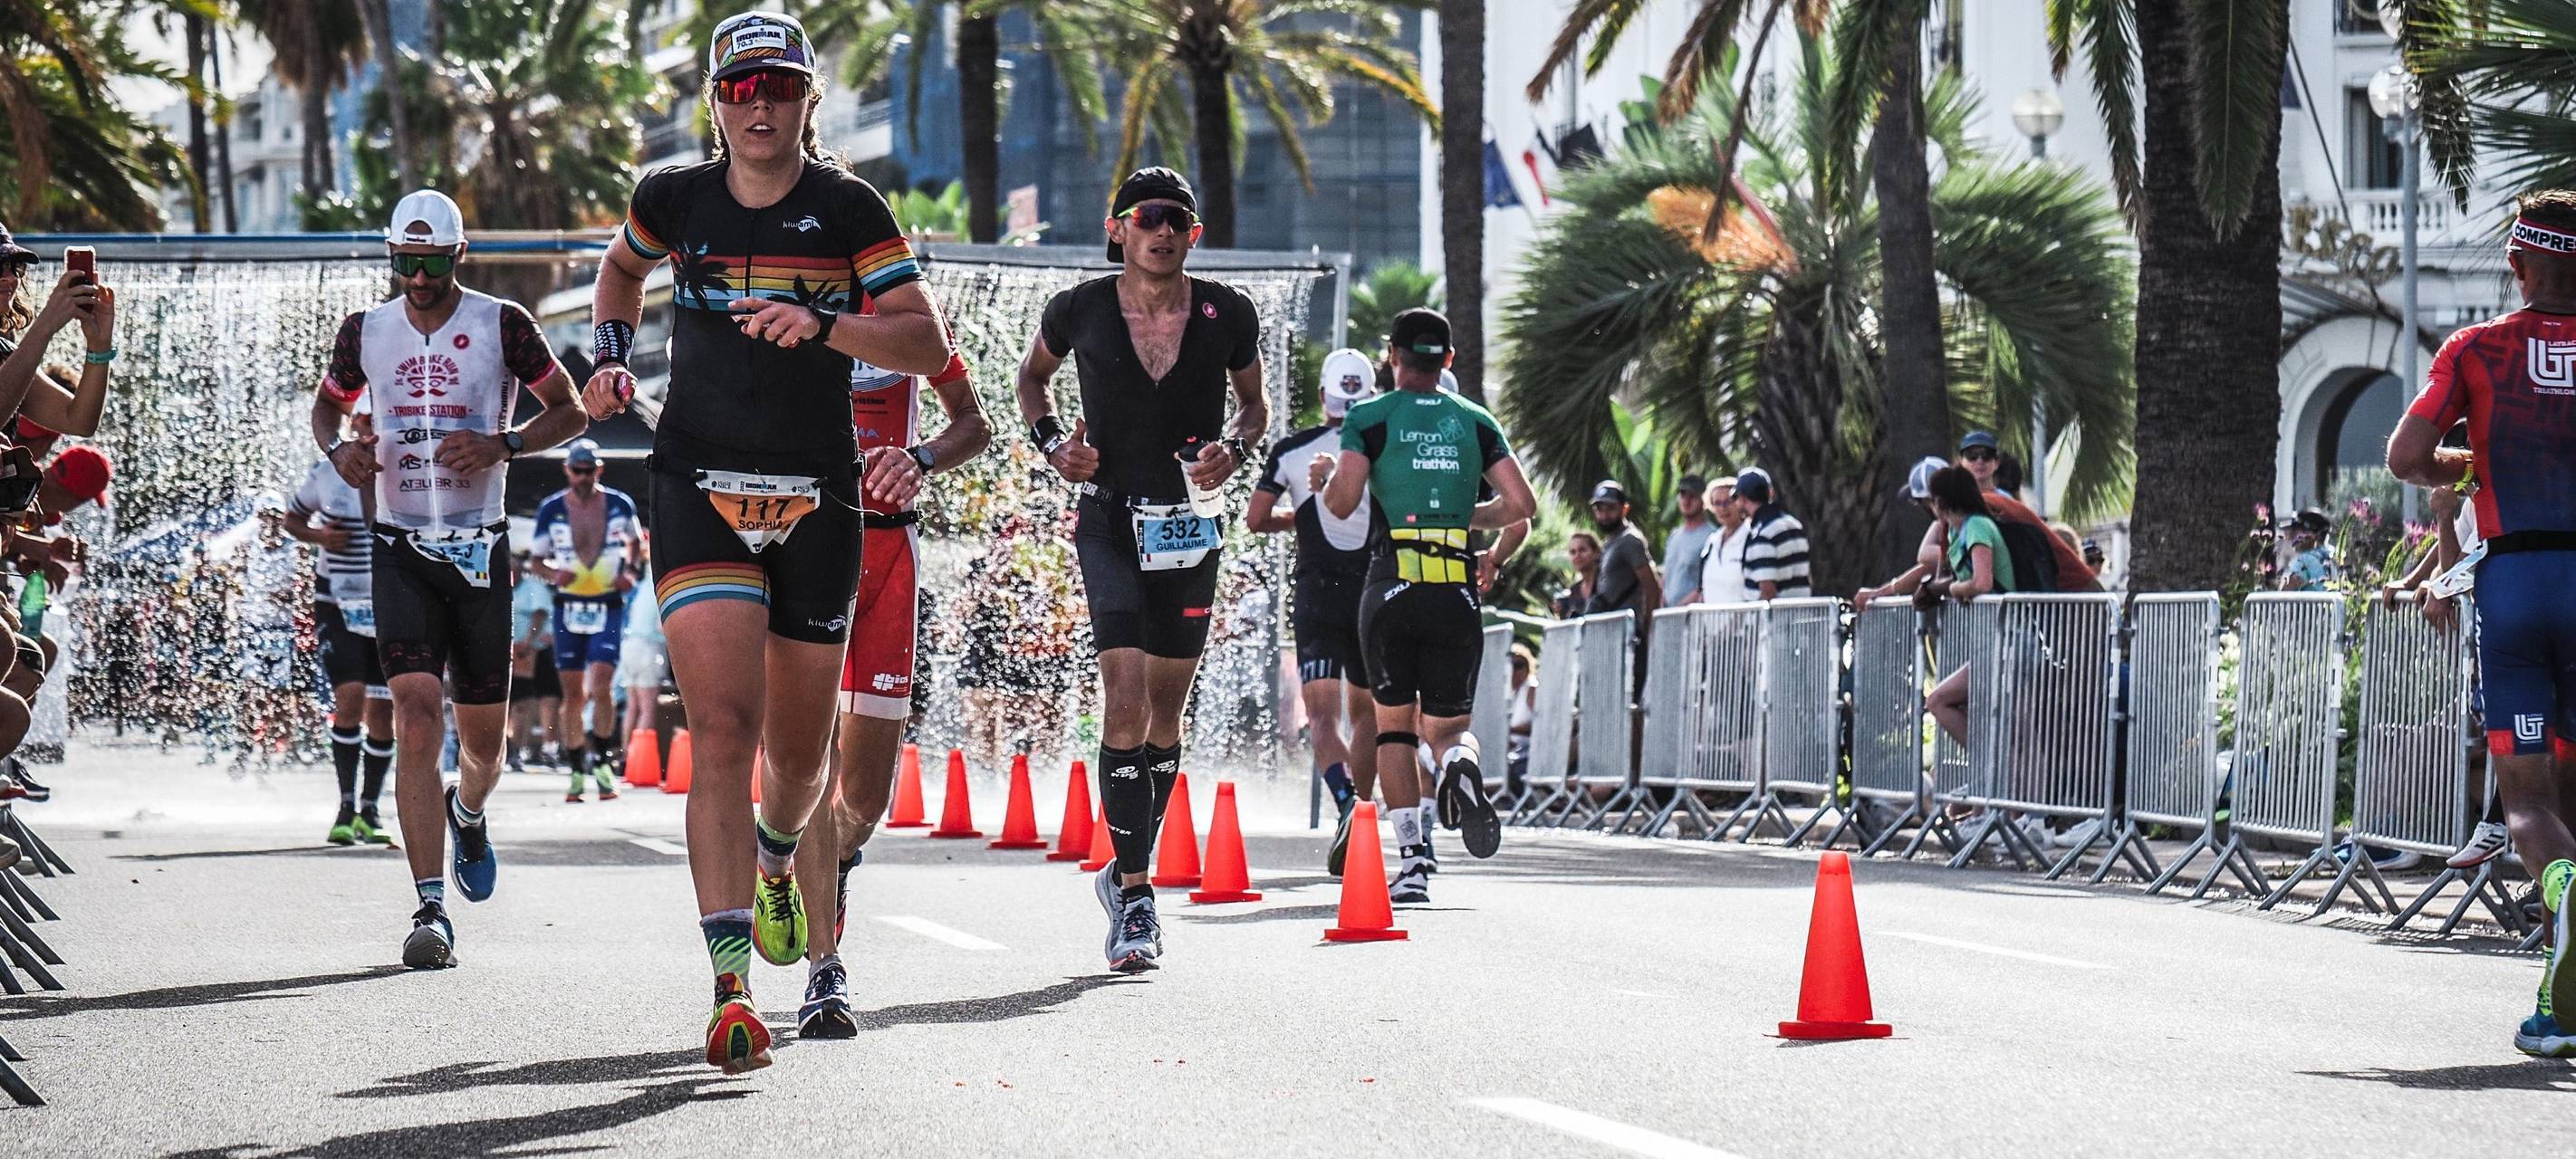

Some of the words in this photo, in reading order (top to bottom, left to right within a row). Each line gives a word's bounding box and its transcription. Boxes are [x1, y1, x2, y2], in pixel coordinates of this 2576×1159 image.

[736, 29, 781, 43] IRONMAN
[2515, 224, 2576, 252] COMPRE
[395, 356, 418, 377] SWIM
[393, 405, 427, 417] TRIBIKE
[429, 404, 467, 419] STATION
[1399, 429, 1443, 443] Lemon
[1417, 442, 1459, 457] Grass
[1412, 457, 1460, 471] triathlon
[745, 481, 777, 490] IRONMAN
[736, 498, 792, 520] 117
[1161, 518, 1202, 541] 532
[1156, 538, 1208, 551] GUILLAUME
